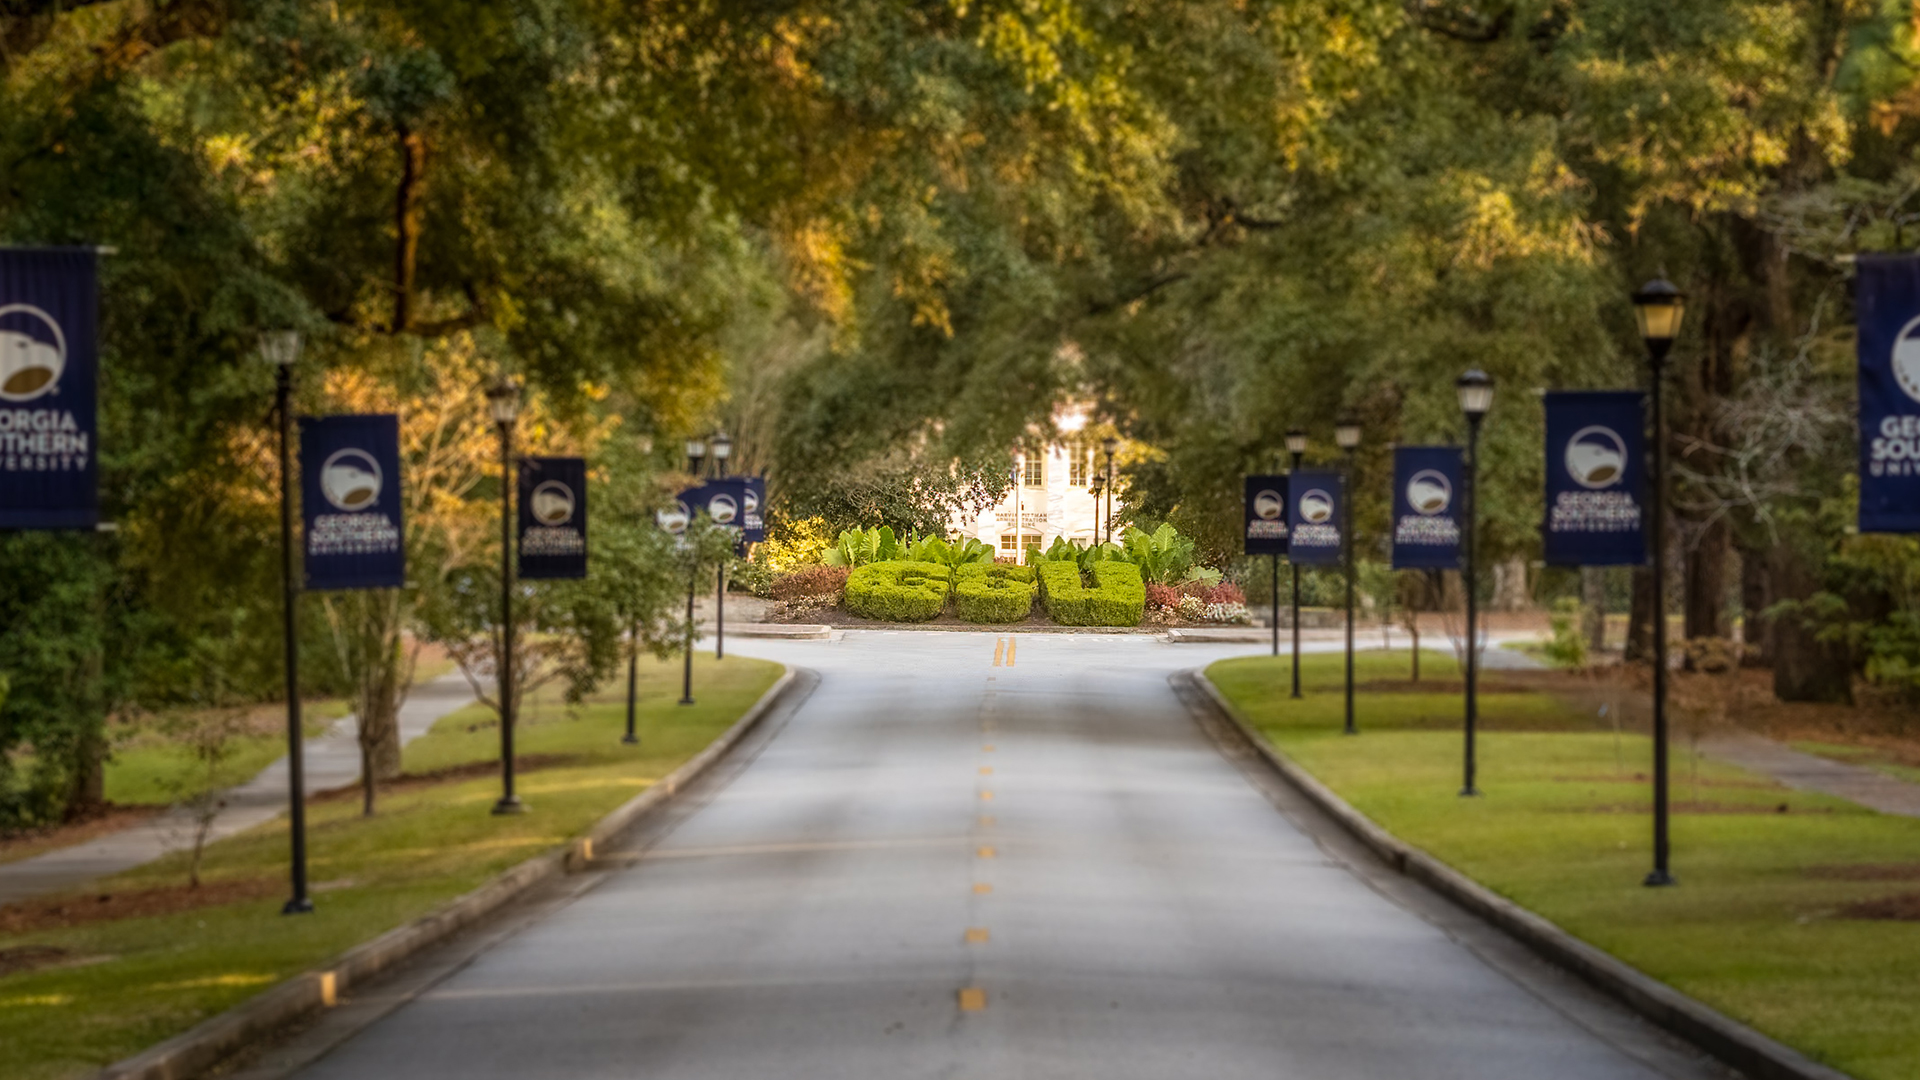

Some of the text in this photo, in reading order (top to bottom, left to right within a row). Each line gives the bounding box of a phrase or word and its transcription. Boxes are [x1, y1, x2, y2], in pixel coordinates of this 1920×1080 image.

[1880, 414, 1920, 438] GE
[1557, 491, 1634, 507] GEORGIA
[314, 513, 391, 531] GEORGIA
